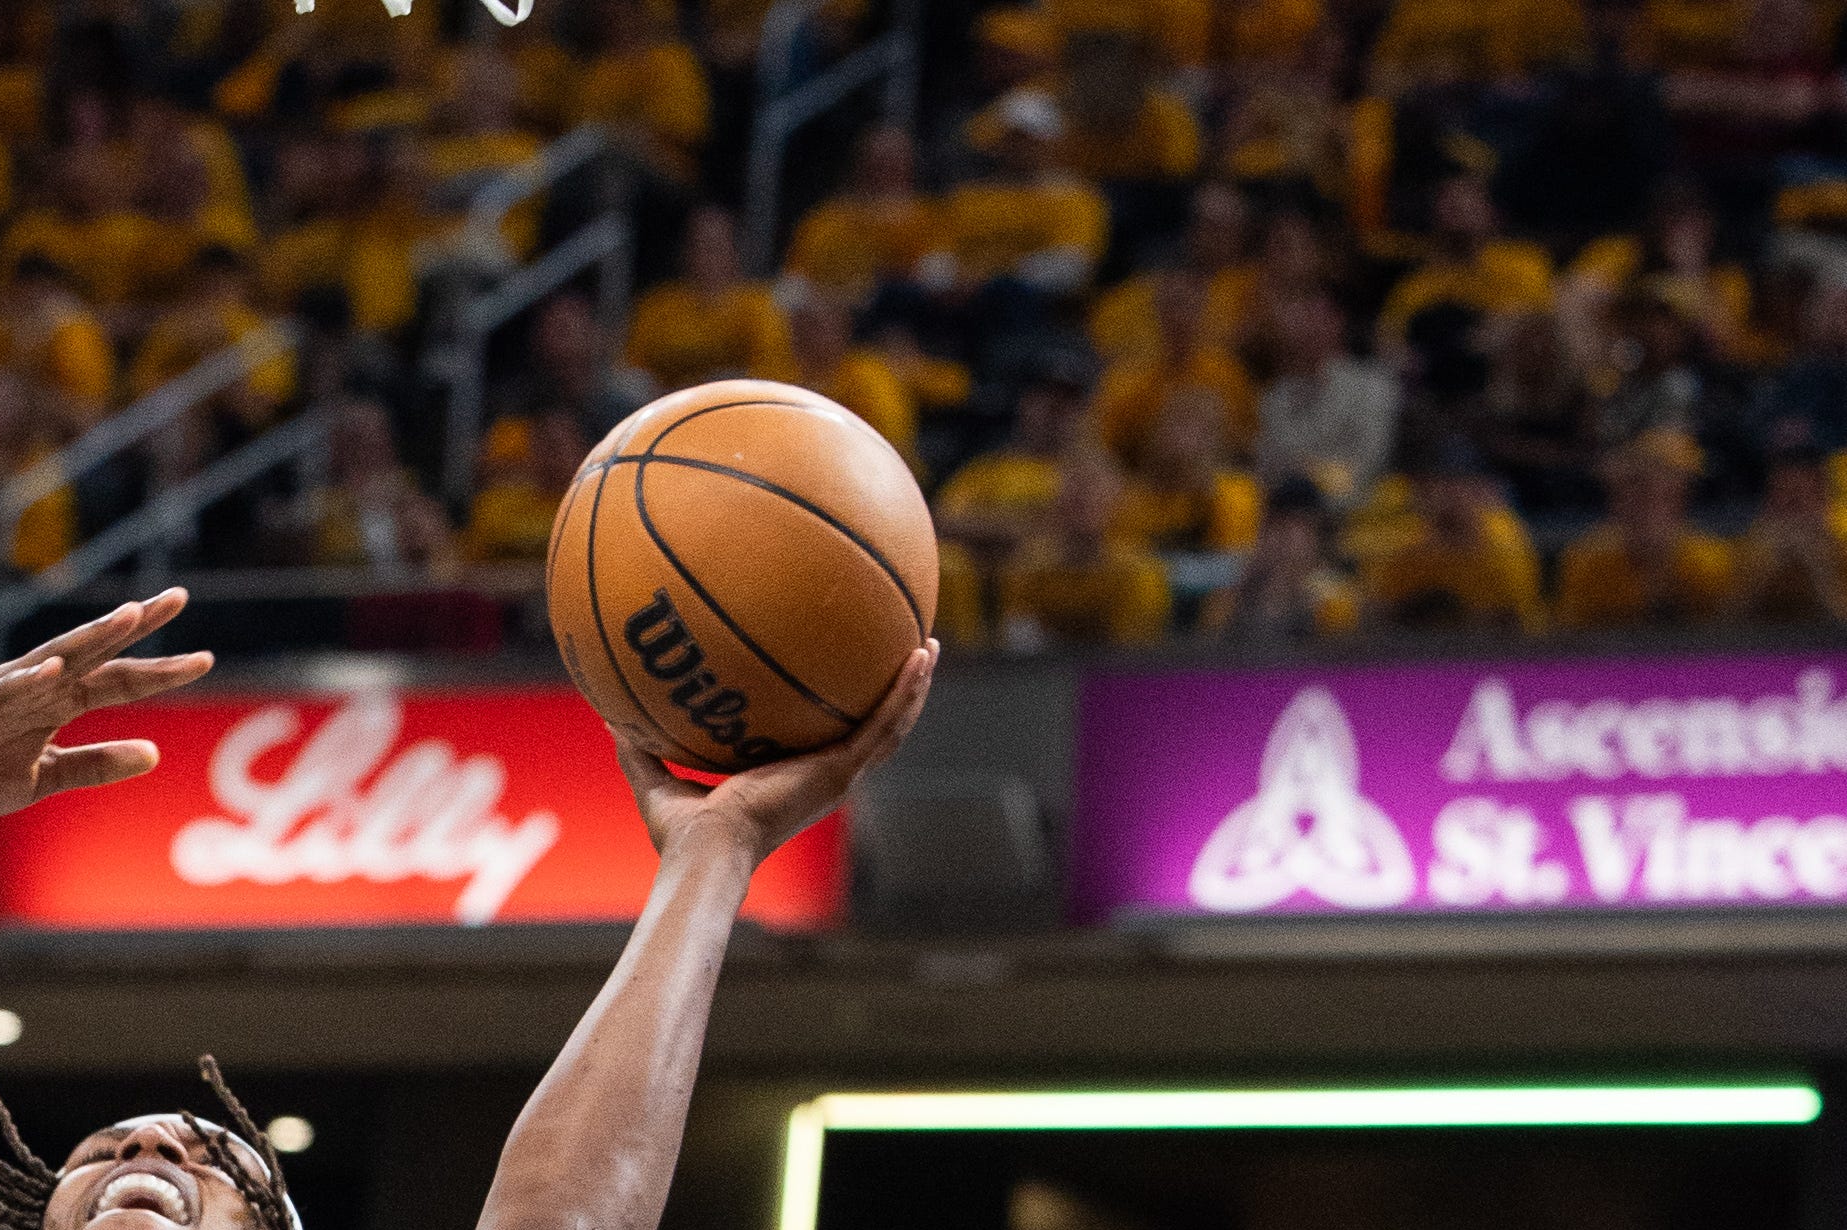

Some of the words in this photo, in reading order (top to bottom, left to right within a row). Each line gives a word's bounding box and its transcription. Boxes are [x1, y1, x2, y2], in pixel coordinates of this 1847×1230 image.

[624, 586, 784, 764] Wilso
[170, 672, 562, 926] Lilly
[1428, 796, 1569, 903] St.
